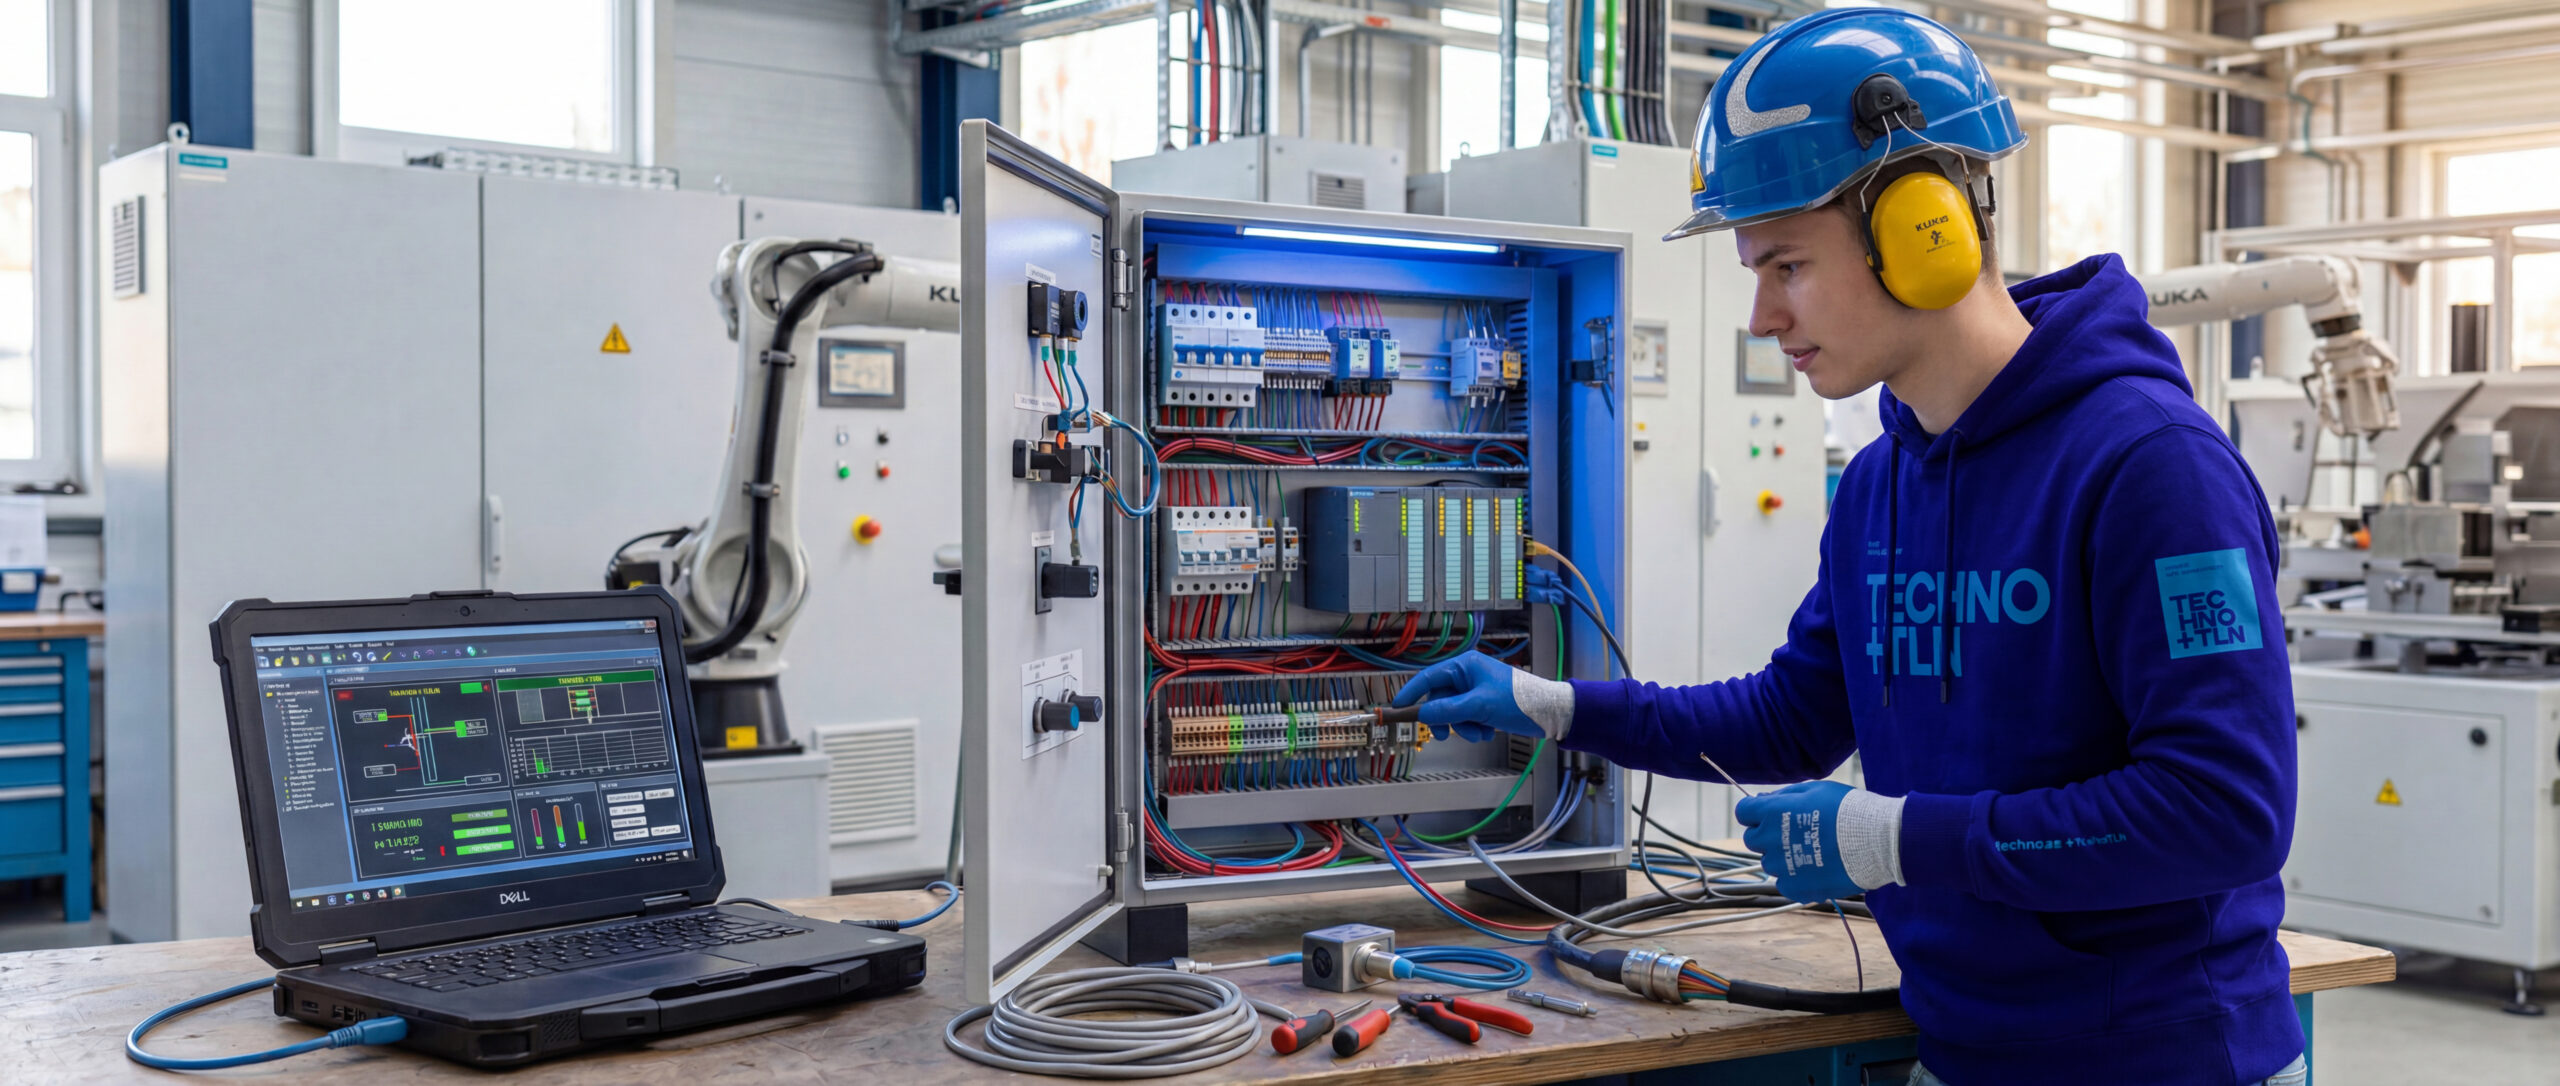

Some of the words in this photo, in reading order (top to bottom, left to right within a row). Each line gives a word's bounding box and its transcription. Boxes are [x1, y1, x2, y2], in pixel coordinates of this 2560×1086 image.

[2150, 286, 2209, 307] UKA
[1866, 568, 2051, 624] TECHNO
[2168, 589, 2226, 614] TEC
[2178, 608, 2236, 631] HNO
[2177, 625, 2246, 649] +TLN
[1866, 626, 1963, 677] +TLN
[499, 890, 530, 905] DELL
